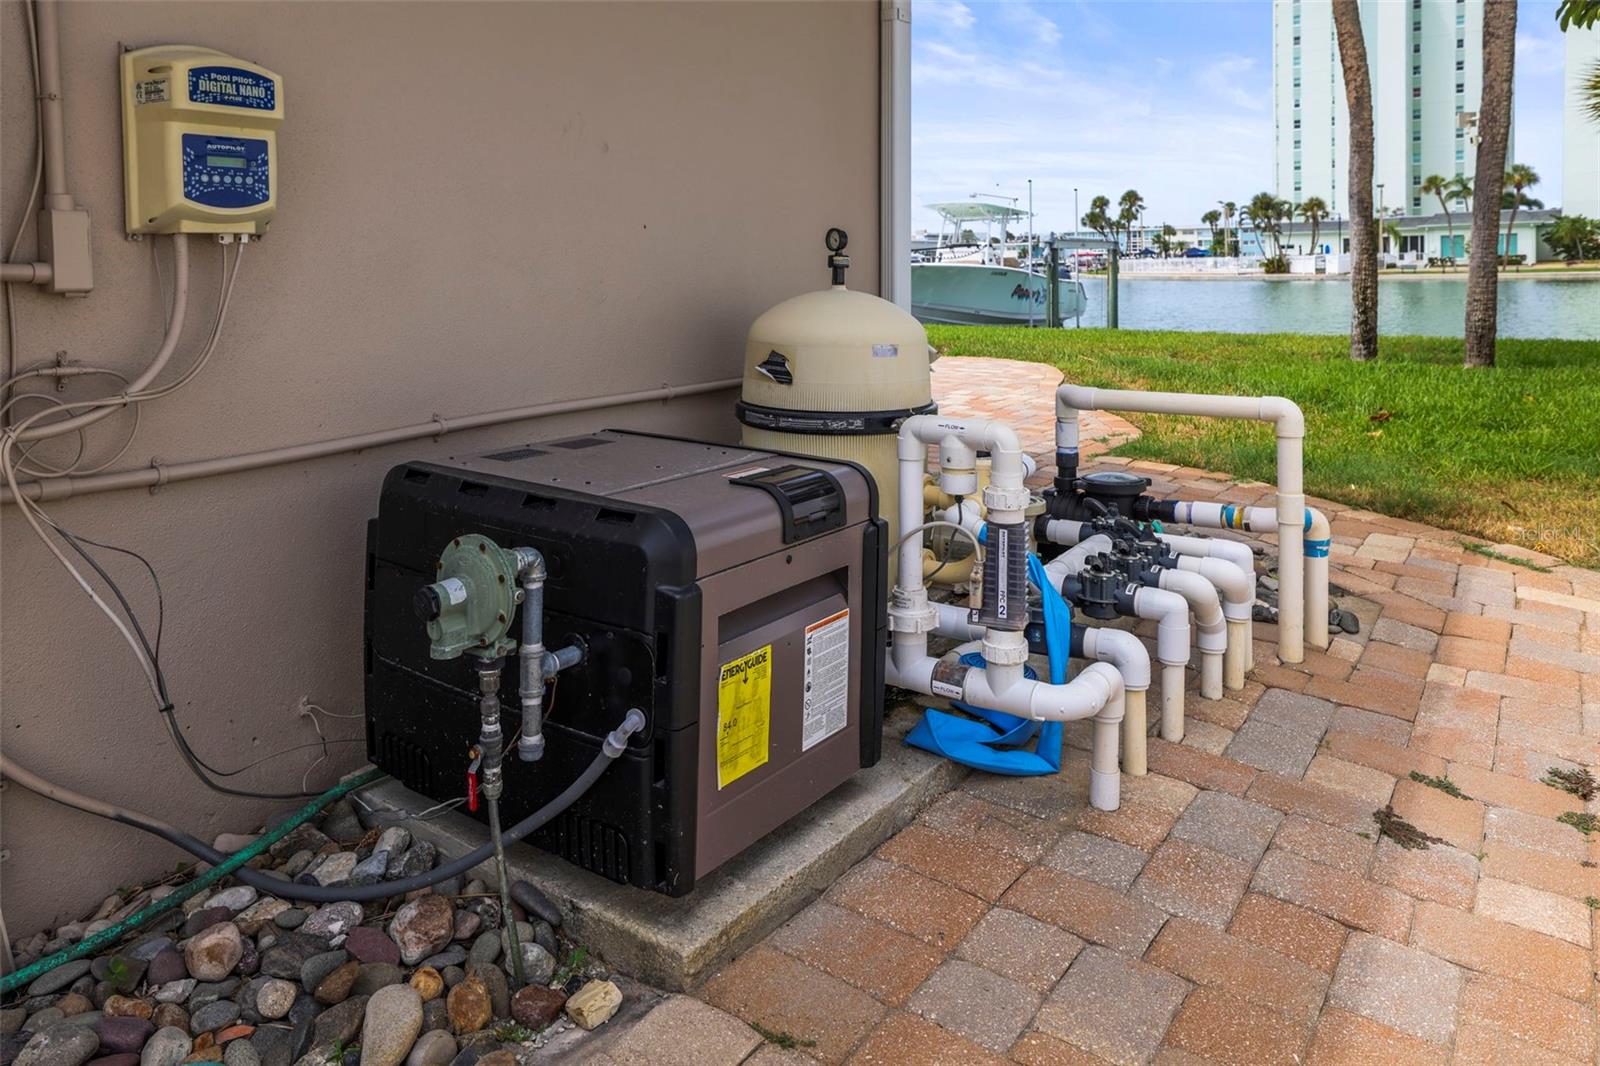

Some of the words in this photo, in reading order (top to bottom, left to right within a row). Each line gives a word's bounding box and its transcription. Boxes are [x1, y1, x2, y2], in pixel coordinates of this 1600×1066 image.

[211, 73, 230, 82] Pool
[199, 79, 237, 95] DIGITAL
[239, 84, 266, 98] NANO
[999, 605, 1006, 615] 2
